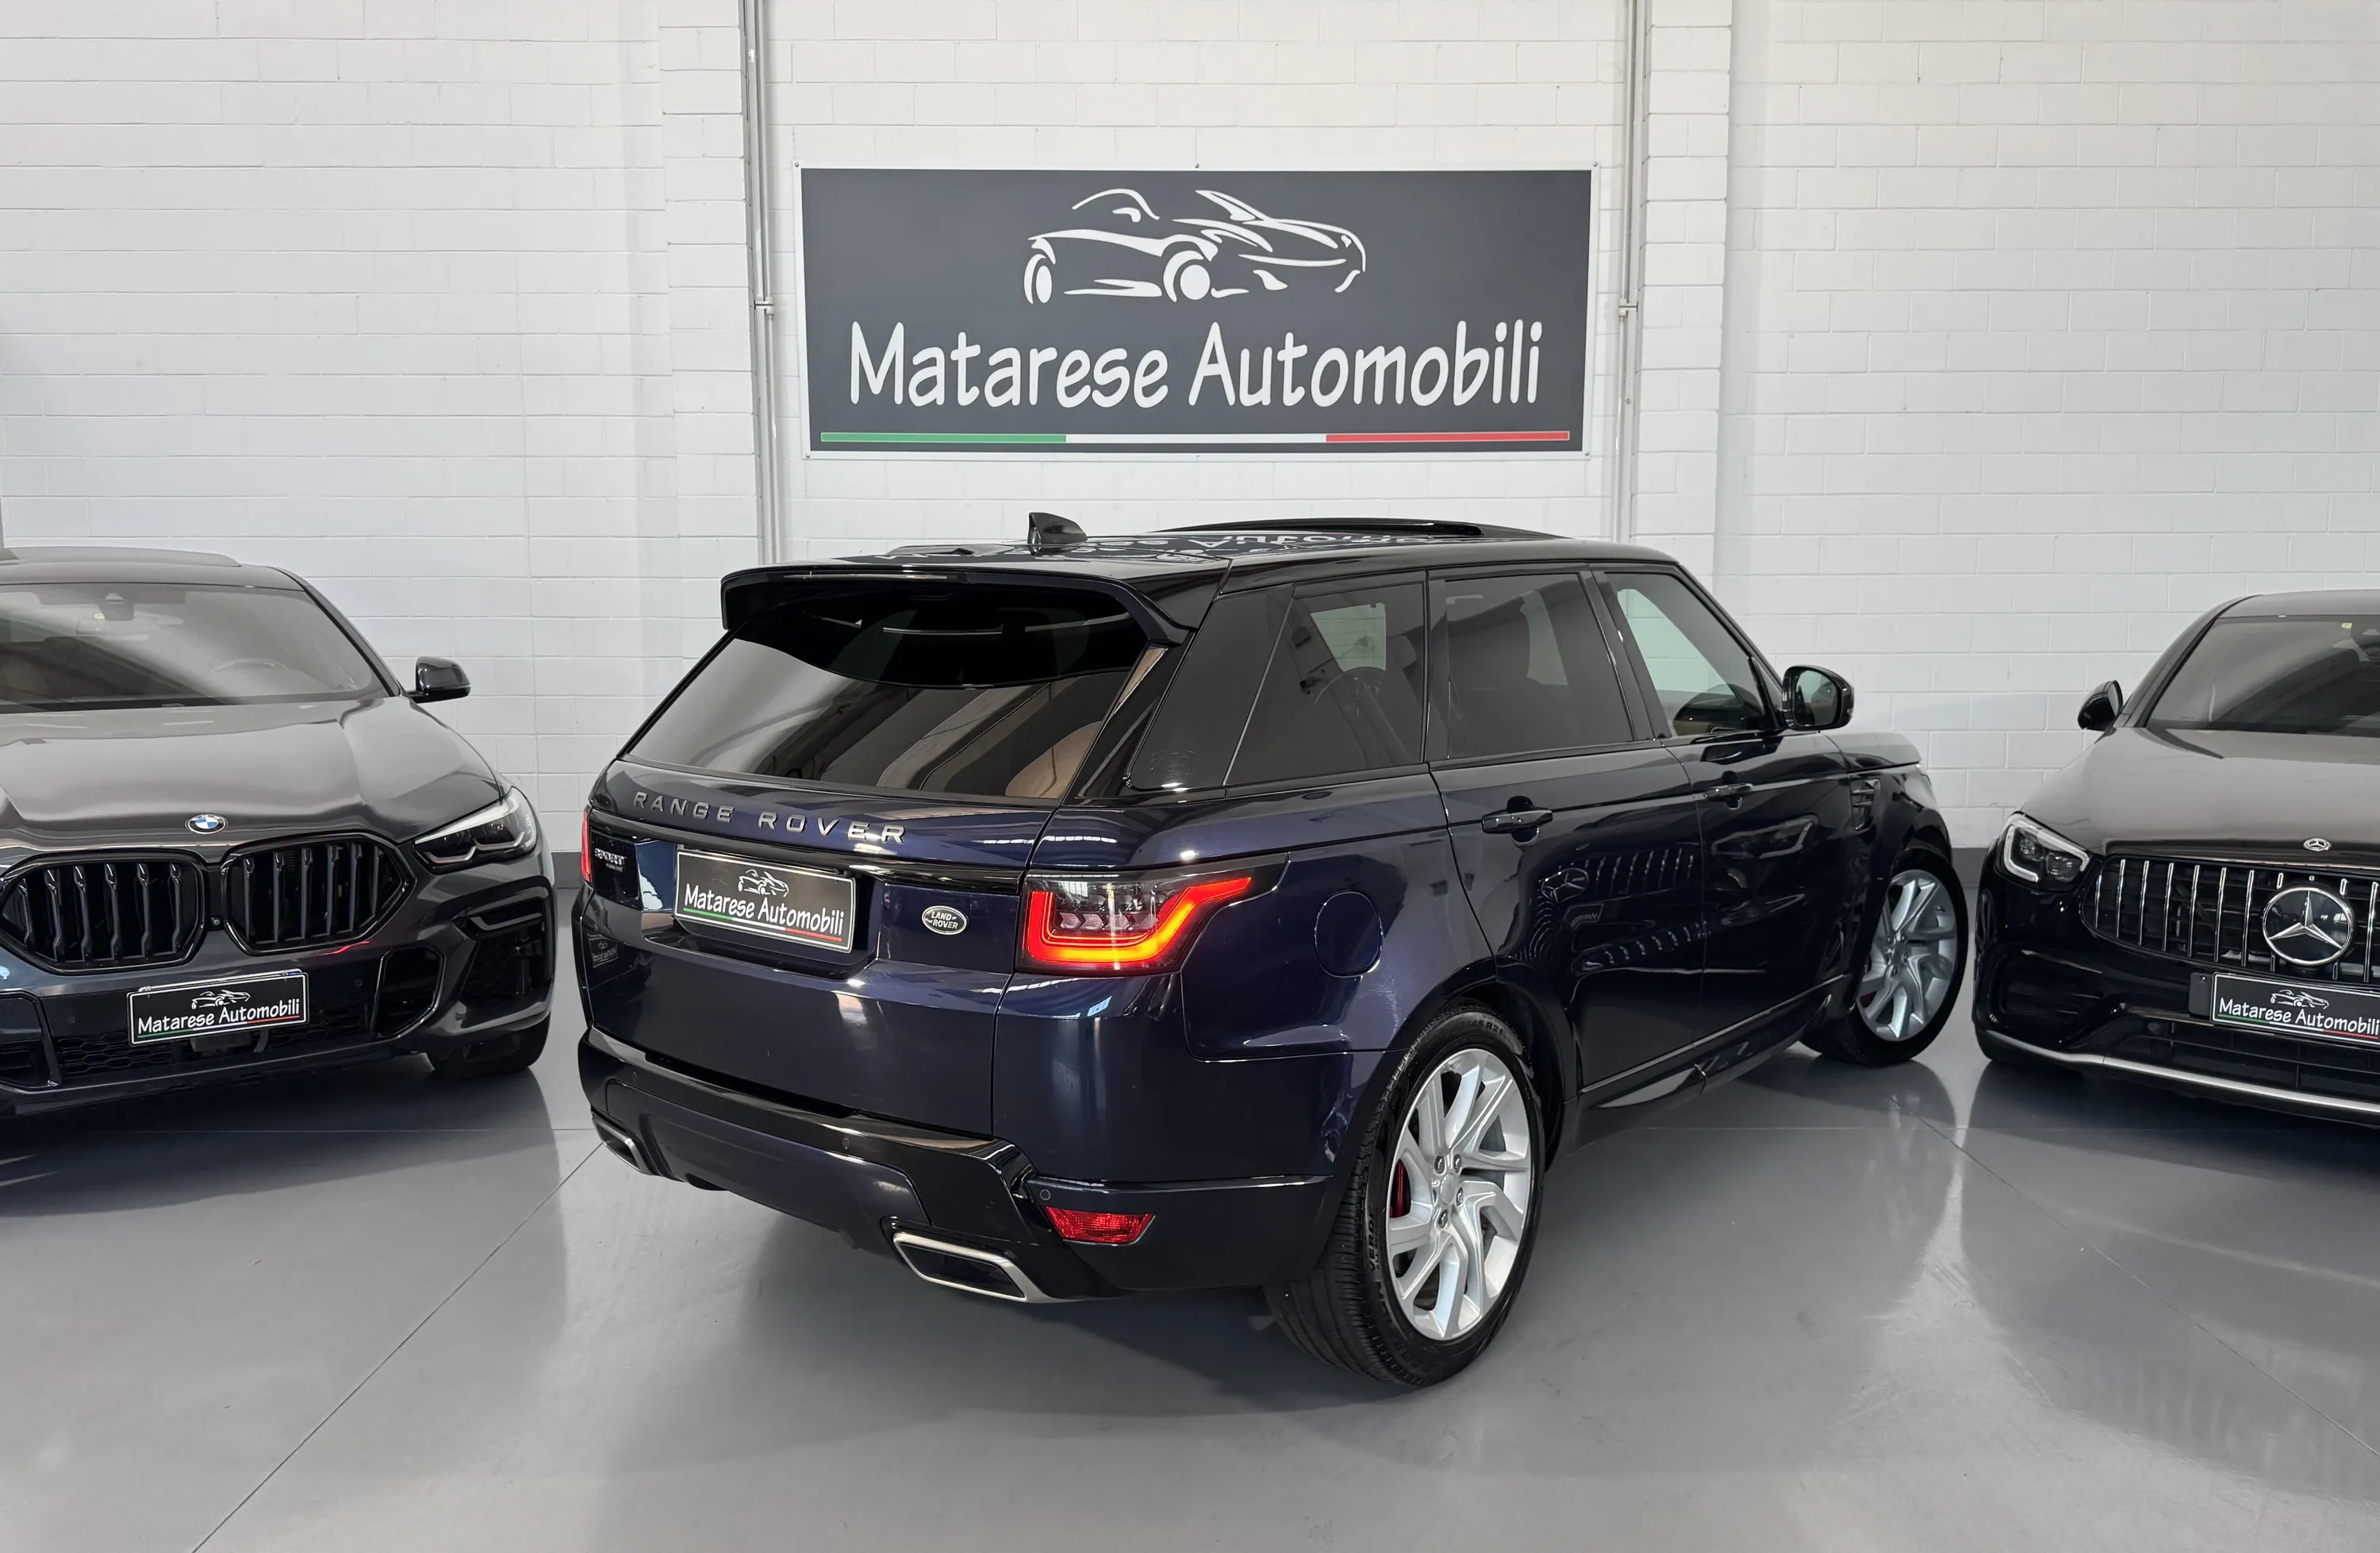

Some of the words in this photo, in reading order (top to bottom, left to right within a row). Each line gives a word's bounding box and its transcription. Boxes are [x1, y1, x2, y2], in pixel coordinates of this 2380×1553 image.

[850, 321, 1169, 408] Matarese
[1188, 319, 1544, 407] Automobili
[634, 791, 735, 823] RANGE
[758, 811, 906, 844] ROVER
[684, 883, 755, 919] Matarese
[758, 898, 844, 936] Automobili
[931, 911, 952, 921] LAND
[932, 919, 958, 930] ROVER
[137, 1013, 215, 1034] Matarese
[218, 998, 300, 1024] Automobili
[2219, 997, 2292, 1023] Matarese
[2295, 1008, 2380, 1035] Automobili
